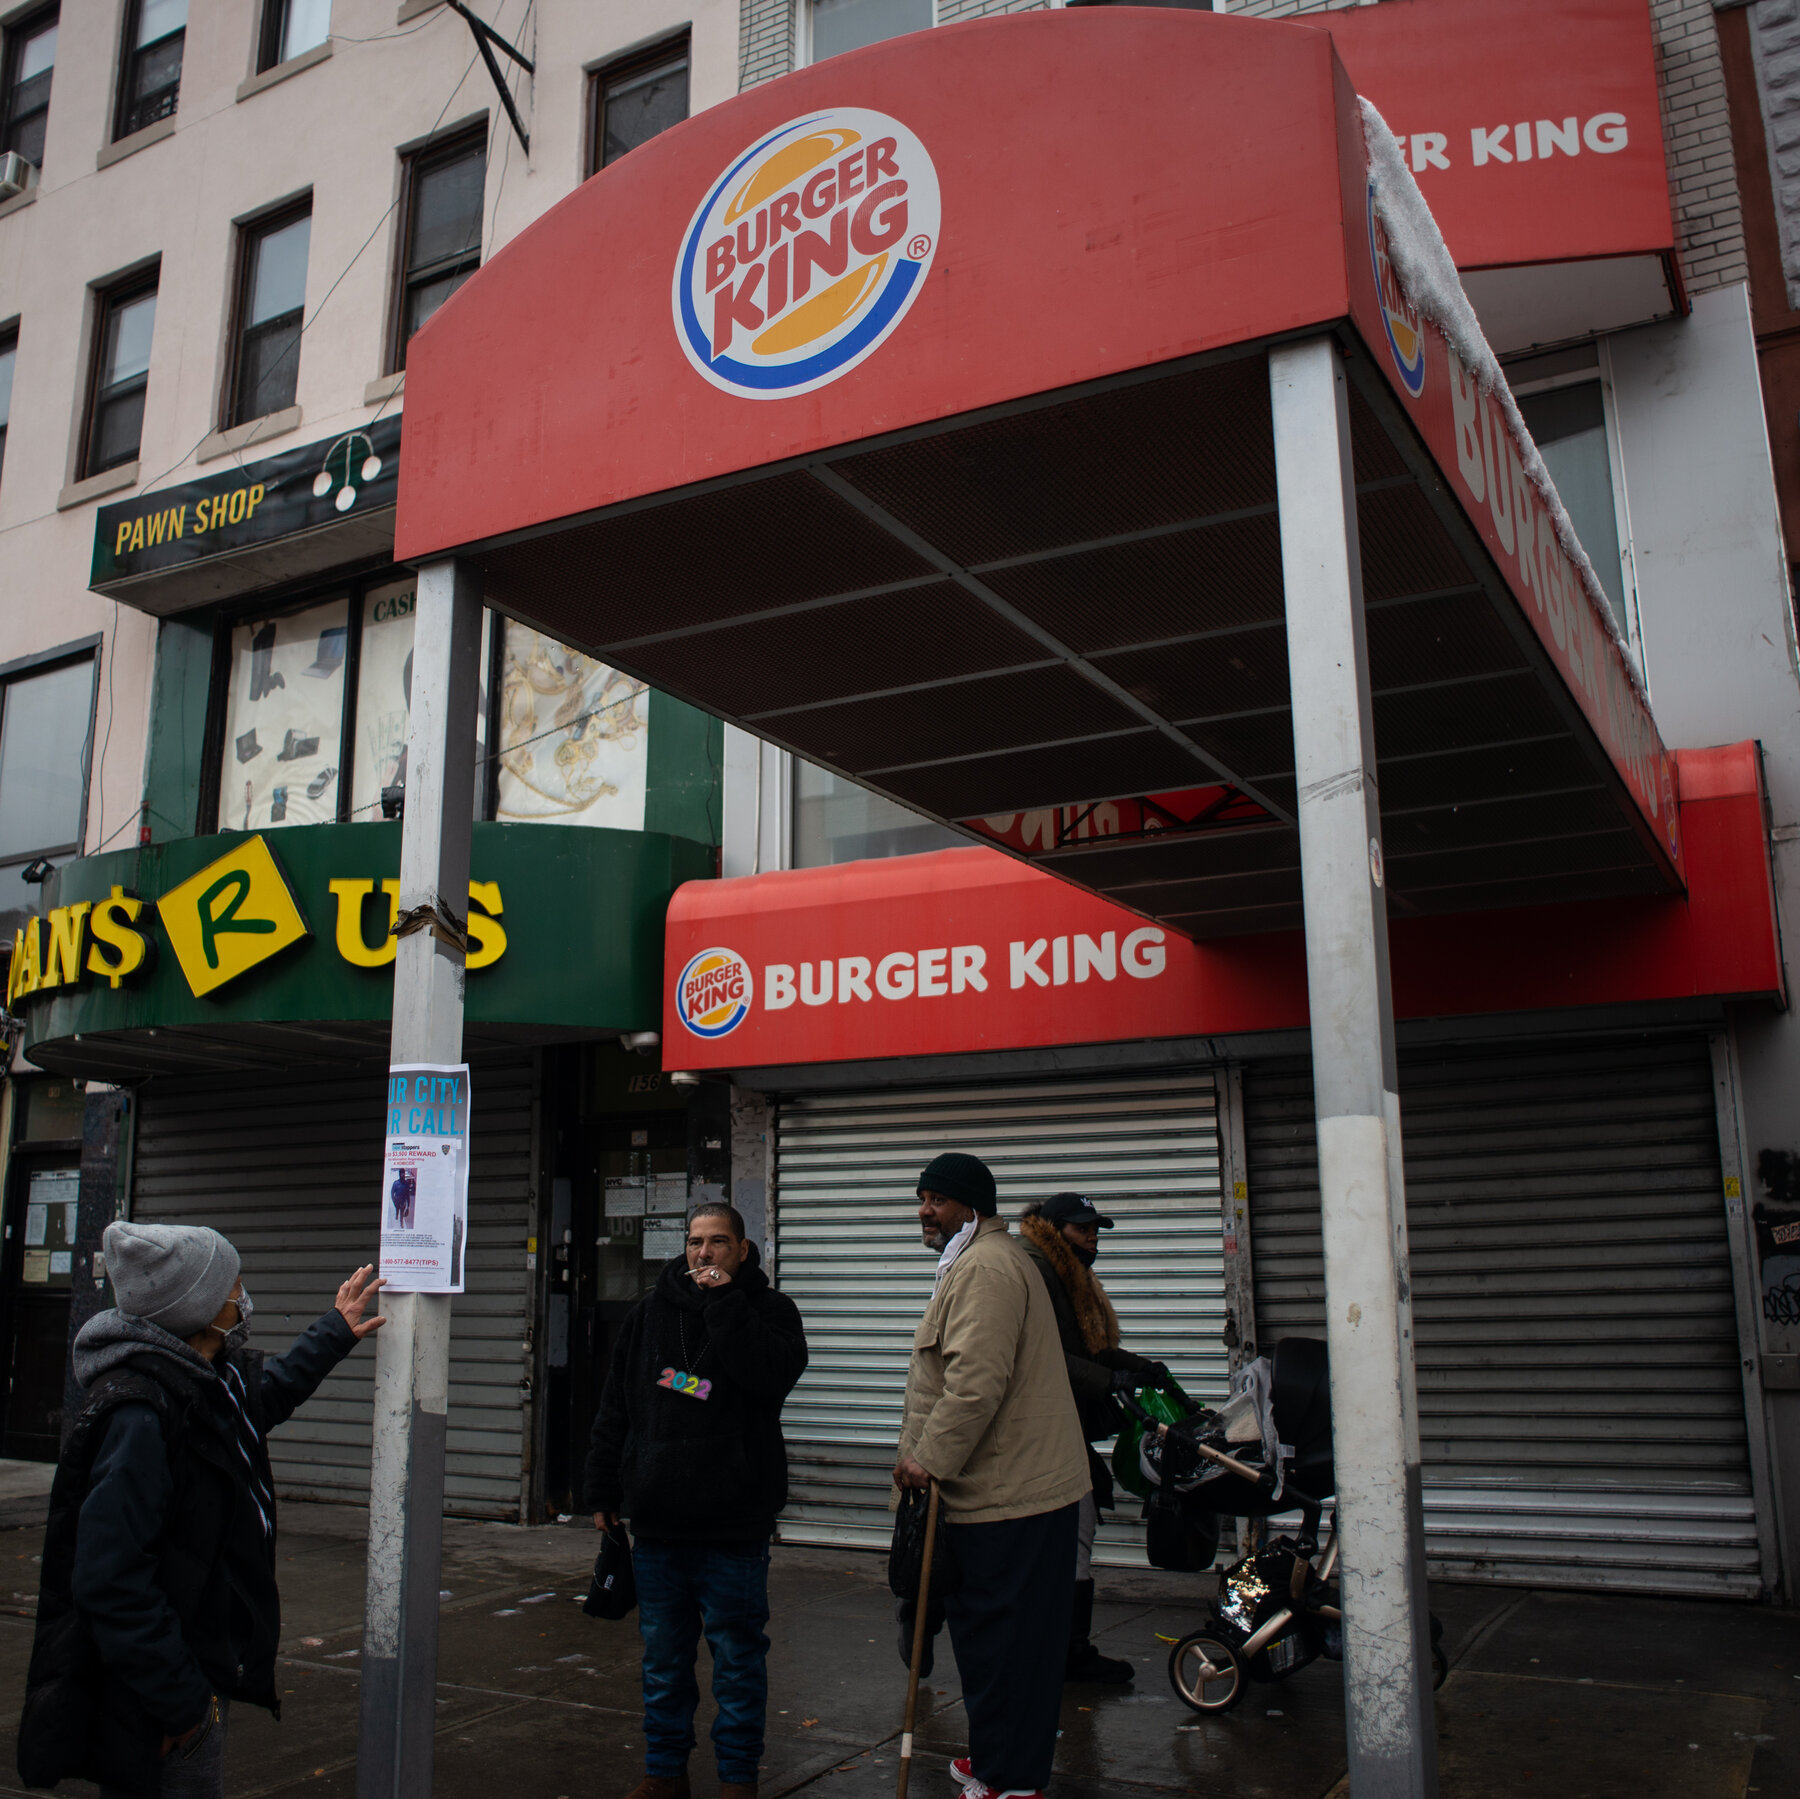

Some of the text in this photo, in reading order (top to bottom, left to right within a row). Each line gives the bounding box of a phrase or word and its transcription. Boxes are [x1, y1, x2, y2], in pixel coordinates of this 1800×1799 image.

[1471, 112, 1628, 167] KING
[705, 136, 900, 295] BURGER
[713, 179, 909, 358] KING
[115, 483, 264, 556] PAWN SHOP
[7, 884, 144, 1009] AN$
[197, 869, 277, 970] R
[686, 962, 742, 999] BURGER
[764, 927, 1166, 1011] BURGER KING
[688, 977, 744, 1021] KING
[414, 1076, 463, 1104] CITY.
[632, 1075, 660, 1091] 156
[408, 1107, 465, 1136] CALL.
[657, 1367, 712, 1400] 2022
